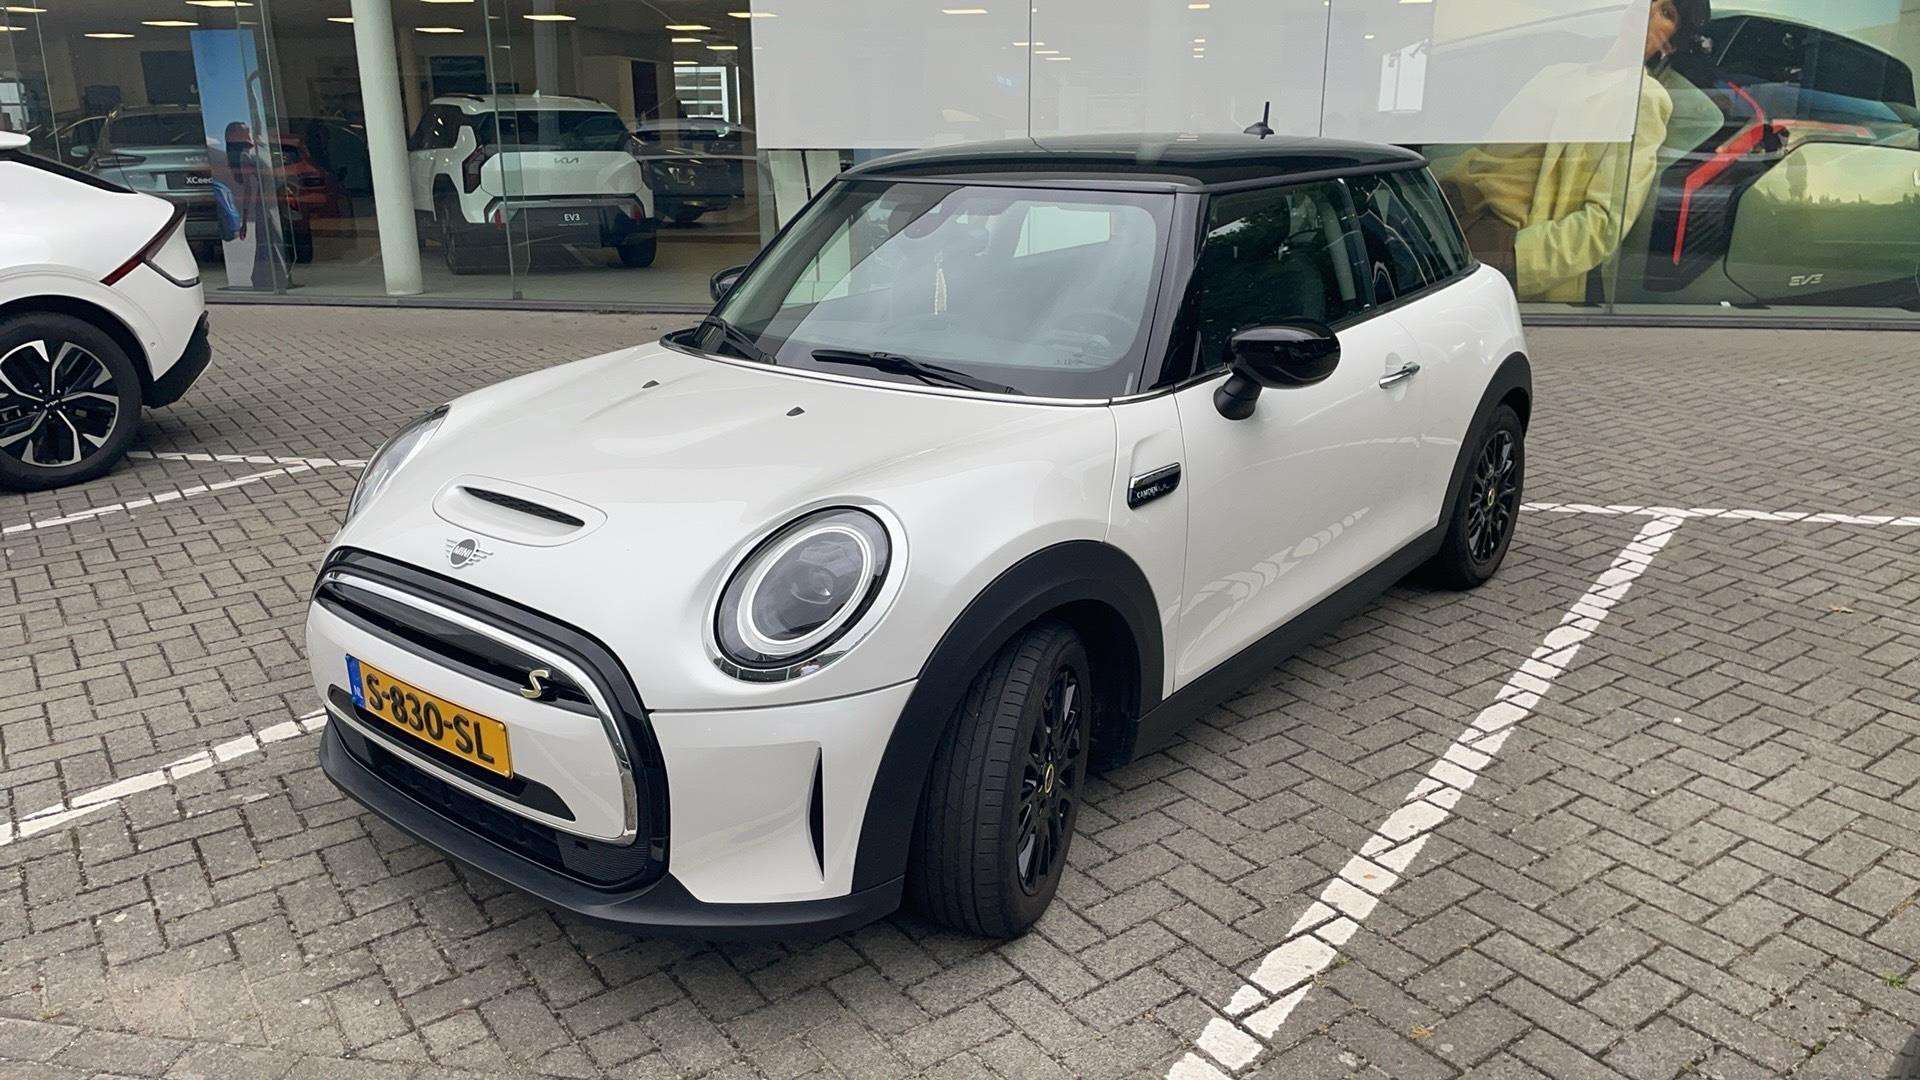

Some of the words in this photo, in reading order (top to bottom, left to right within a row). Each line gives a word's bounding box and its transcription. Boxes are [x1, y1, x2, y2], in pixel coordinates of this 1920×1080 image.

[564, 213, 581, 221] EV3
[453, 545, 473, 558] MINI
[366, 673, 495, 764] S-830-SL
